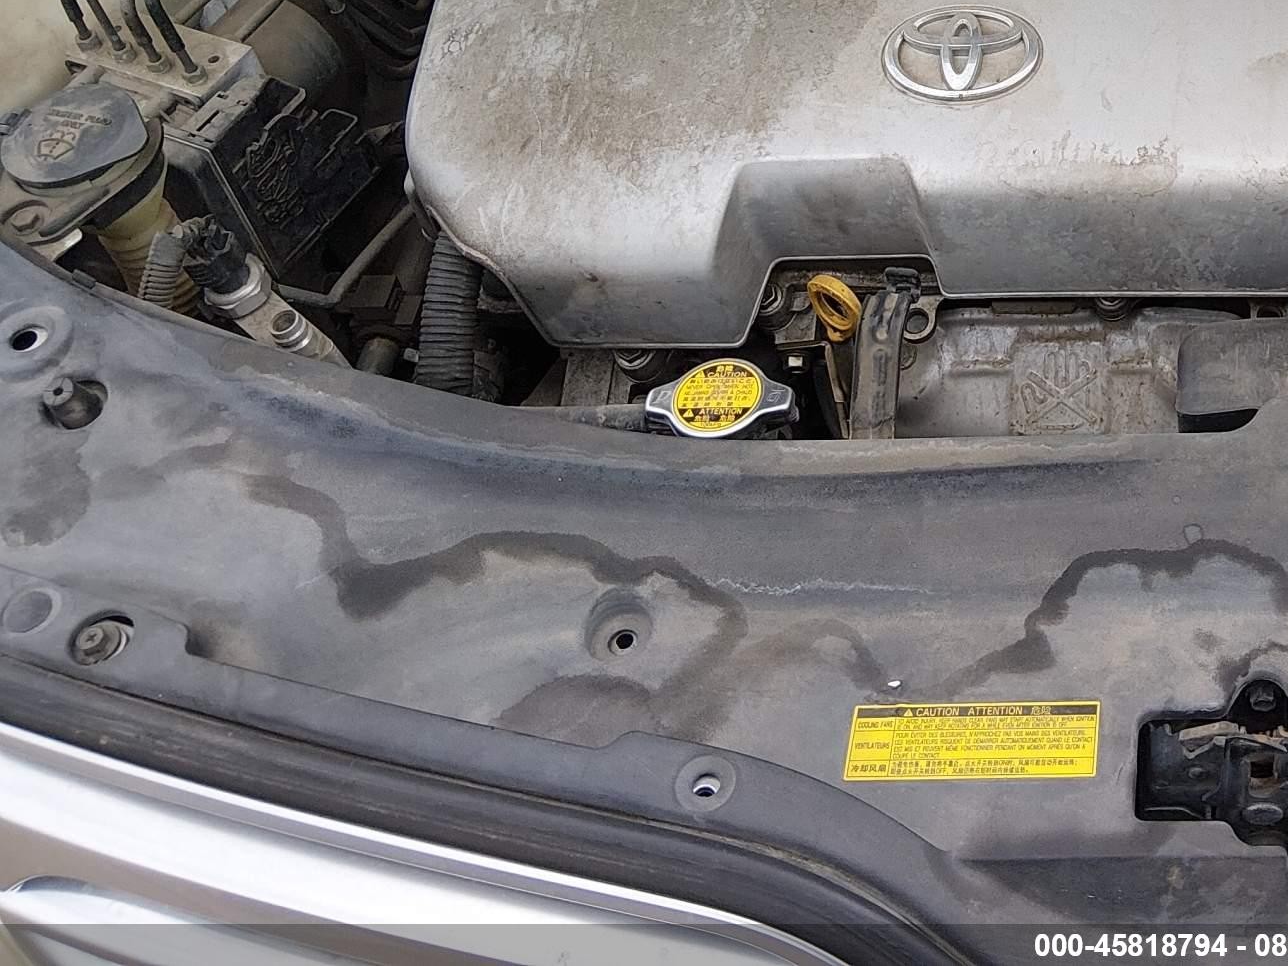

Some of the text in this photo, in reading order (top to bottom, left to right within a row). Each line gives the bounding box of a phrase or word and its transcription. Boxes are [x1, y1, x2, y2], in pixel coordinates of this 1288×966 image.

[916, 707, 960, 717] CAUTION
[967, 706, 1023, 716] ATTENTION
[857, 721, 880, 729] COOLING
[855, 741, 890, 750] VENTILATEURS
